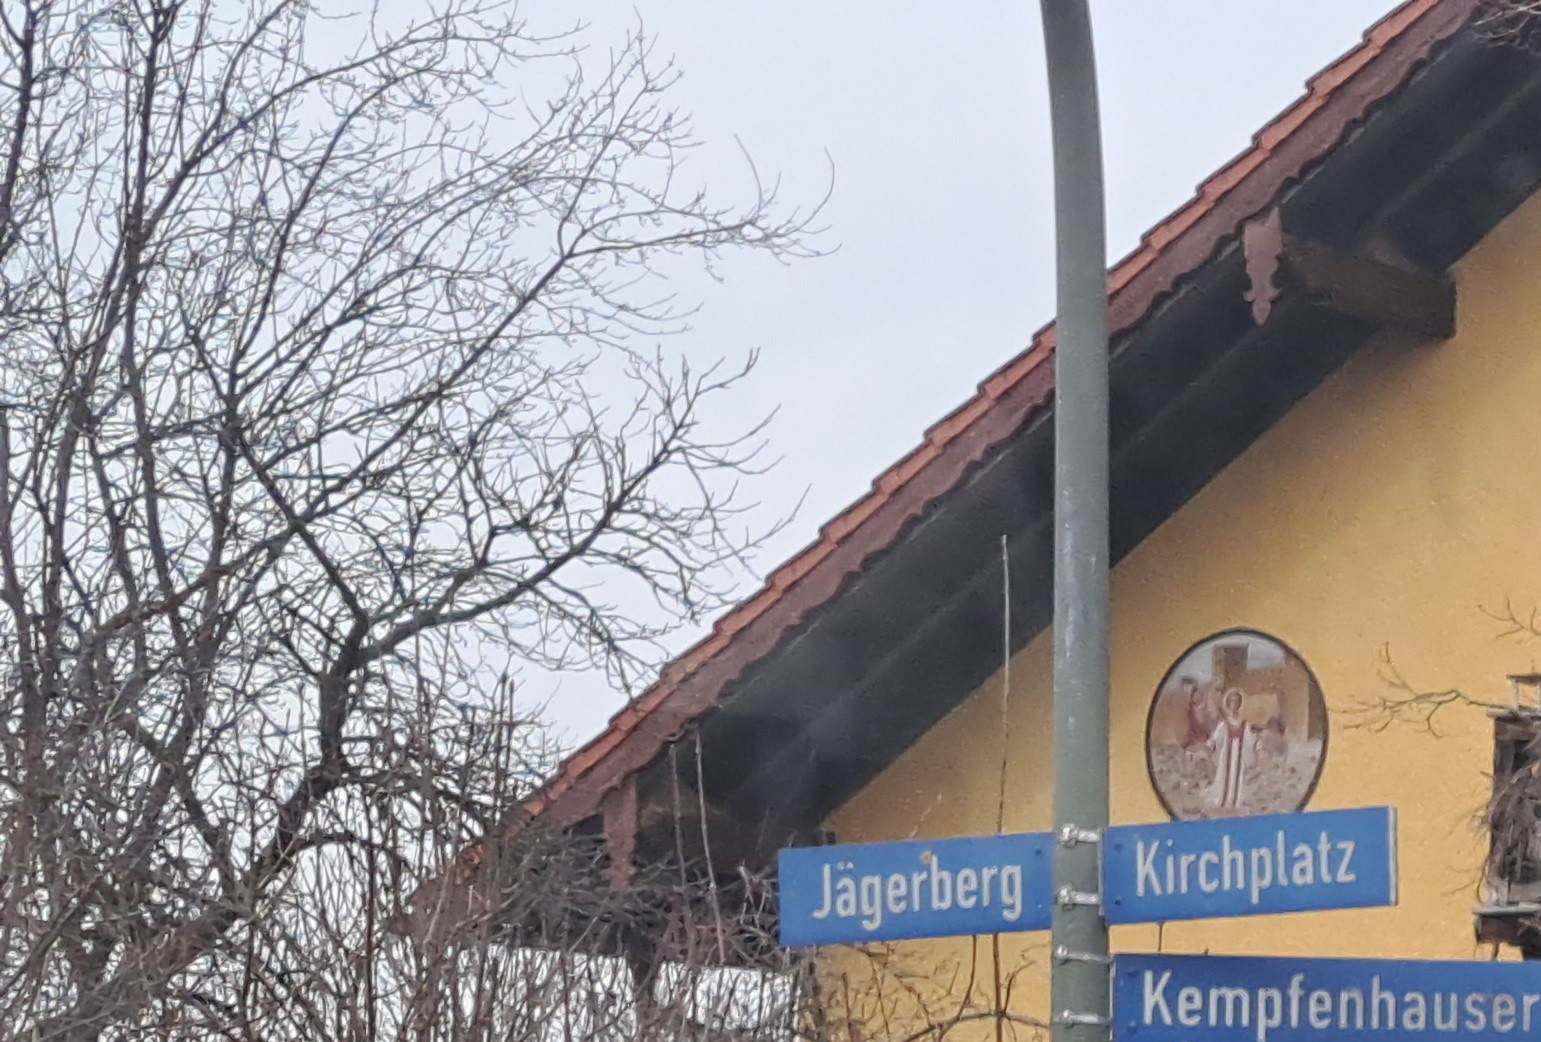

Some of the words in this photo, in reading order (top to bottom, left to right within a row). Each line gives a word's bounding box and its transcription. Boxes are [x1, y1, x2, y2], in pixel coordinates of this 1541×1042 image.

[812, 854, 1022, 931] Jägerberg
[1136, 830, 1356, 904] Kirchplatz
[1143, 969, 1541, 1042] Kempfenhauser
